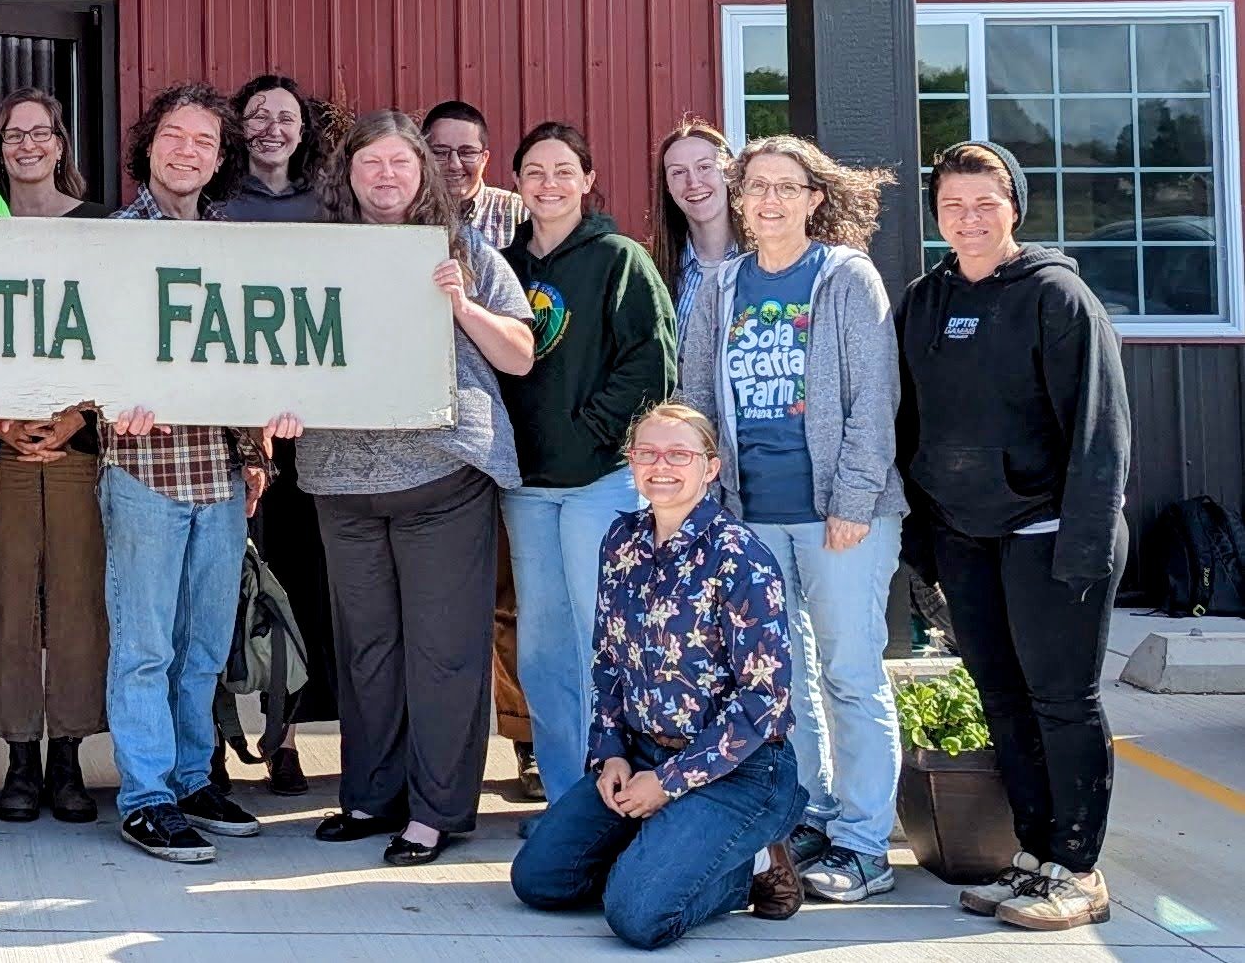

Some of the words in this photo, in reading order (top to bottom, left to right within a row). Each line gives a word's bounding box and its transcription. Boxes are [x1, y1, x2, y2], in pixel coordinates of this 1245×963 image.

[154, 266, 348, 367] FARM
[948, 317, 980, 327] OPTIC
[738, 319, 794, 350] Sola
[727, 347, 805, 380] Gratia
[735, 376, 795, 408] Farm
